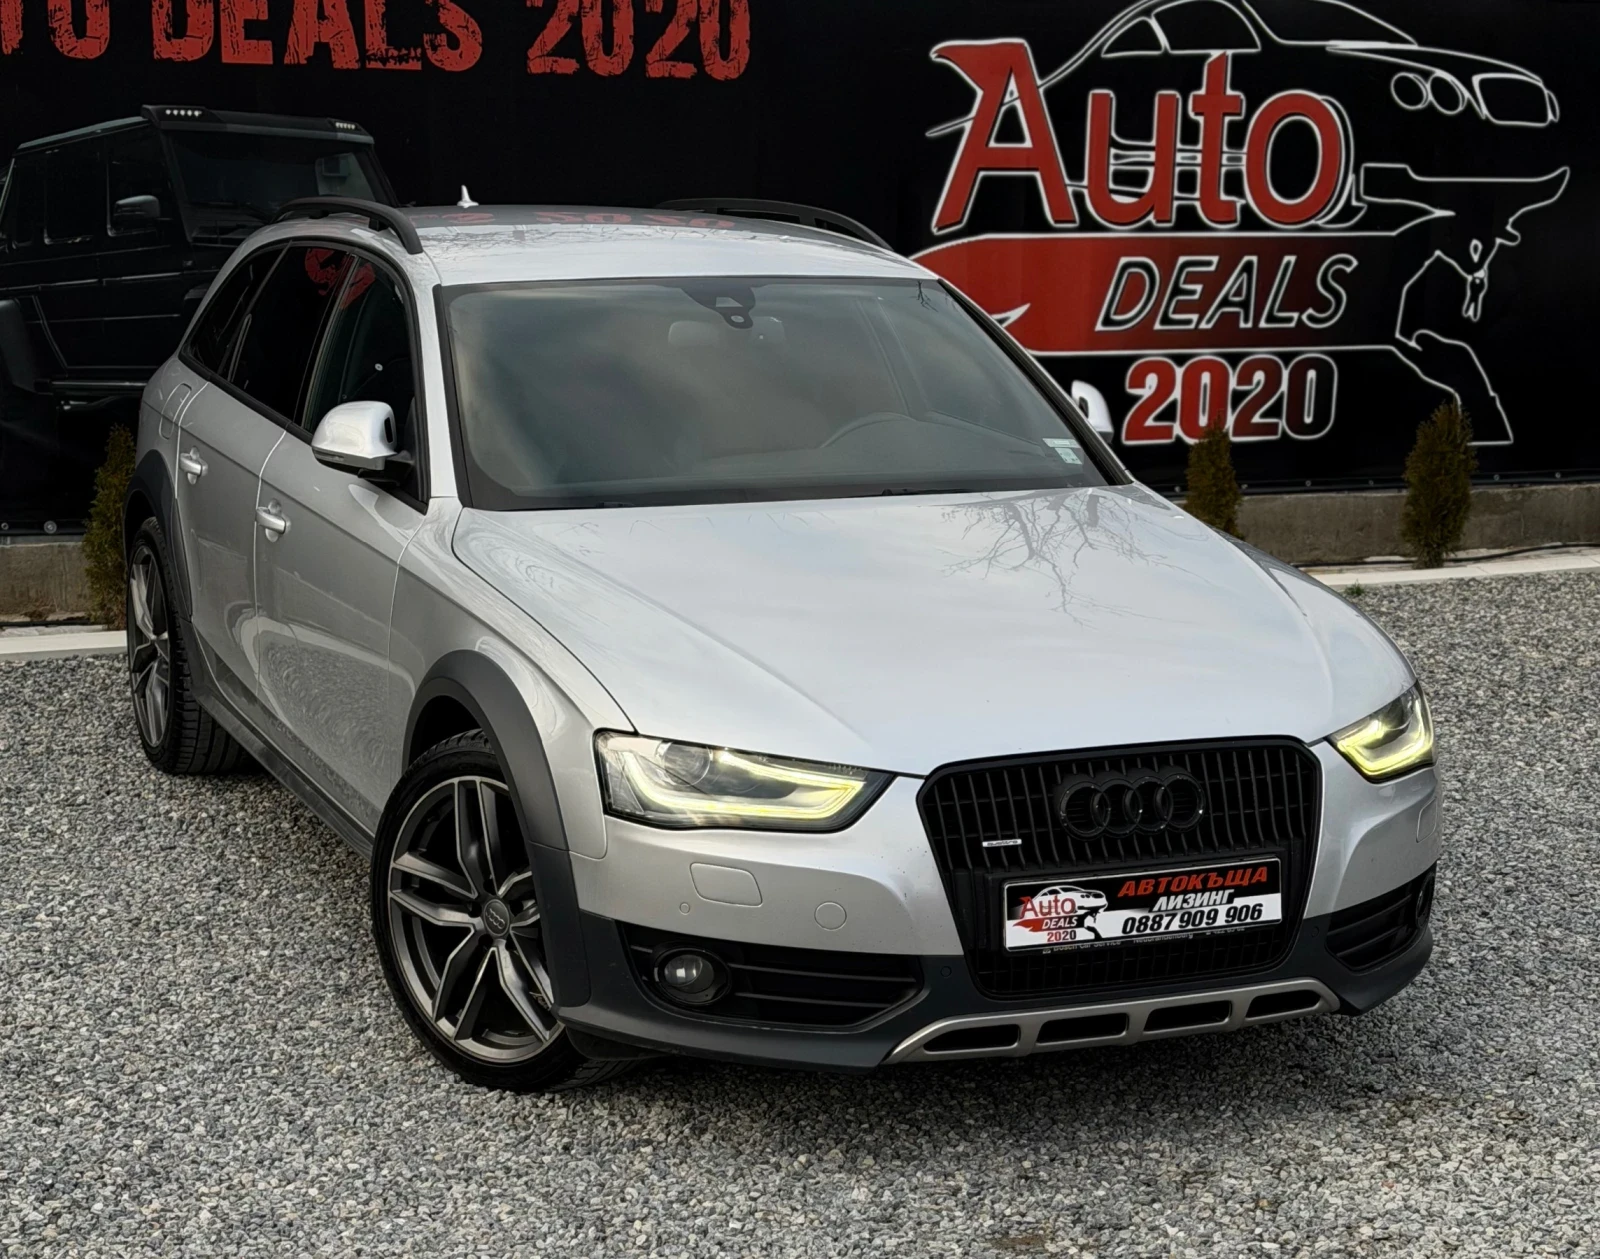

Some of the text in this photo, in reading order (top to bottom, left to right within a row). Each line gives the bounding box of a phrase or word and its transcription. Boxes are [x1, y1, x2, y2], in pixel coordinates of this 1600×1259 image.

[152, 0, 483, 71] DEALS
[526, 0, 750, 80] 2020
[931, 38, 1346, 233] Auto
[1095, 254, 1359, 331] DEALS
[1121, 354, 1338, 444] 2020
[1117, 866, 1268, 897] АВТОКЪЩА
[1019, 894, 1076, 919] Auto
[1152, 889, 1235, 911] ЛИЗИНГ
[1224, 903, 1264, 924] 906
[1041, 917, 1078, 929] DEALS
[1046, 930, 1077, 942] 2020
